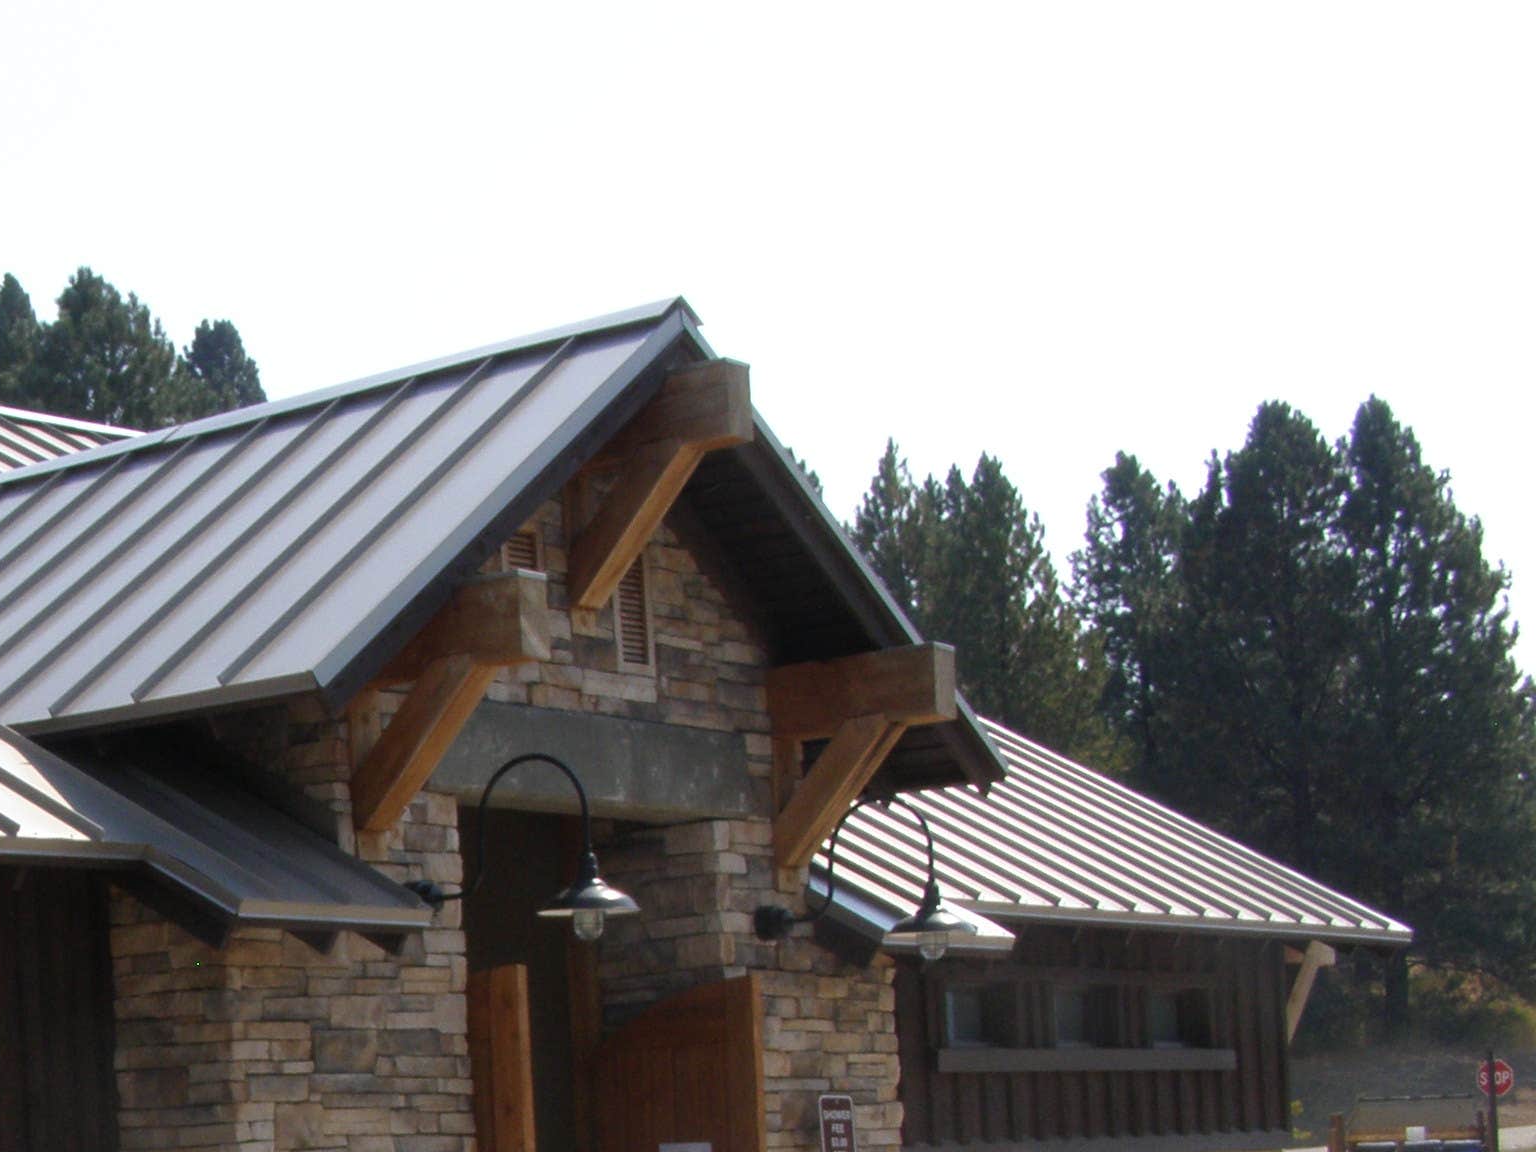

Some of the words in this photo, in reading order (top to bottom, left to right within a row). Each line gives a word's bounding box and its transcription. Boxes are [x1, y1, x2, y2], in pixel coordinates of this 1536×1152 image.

[1479, 1072, 1510, 1085] SOP
[823, 1110, 851, 1120] SHOWER
[831, 1123, 845, 1133] FEE
